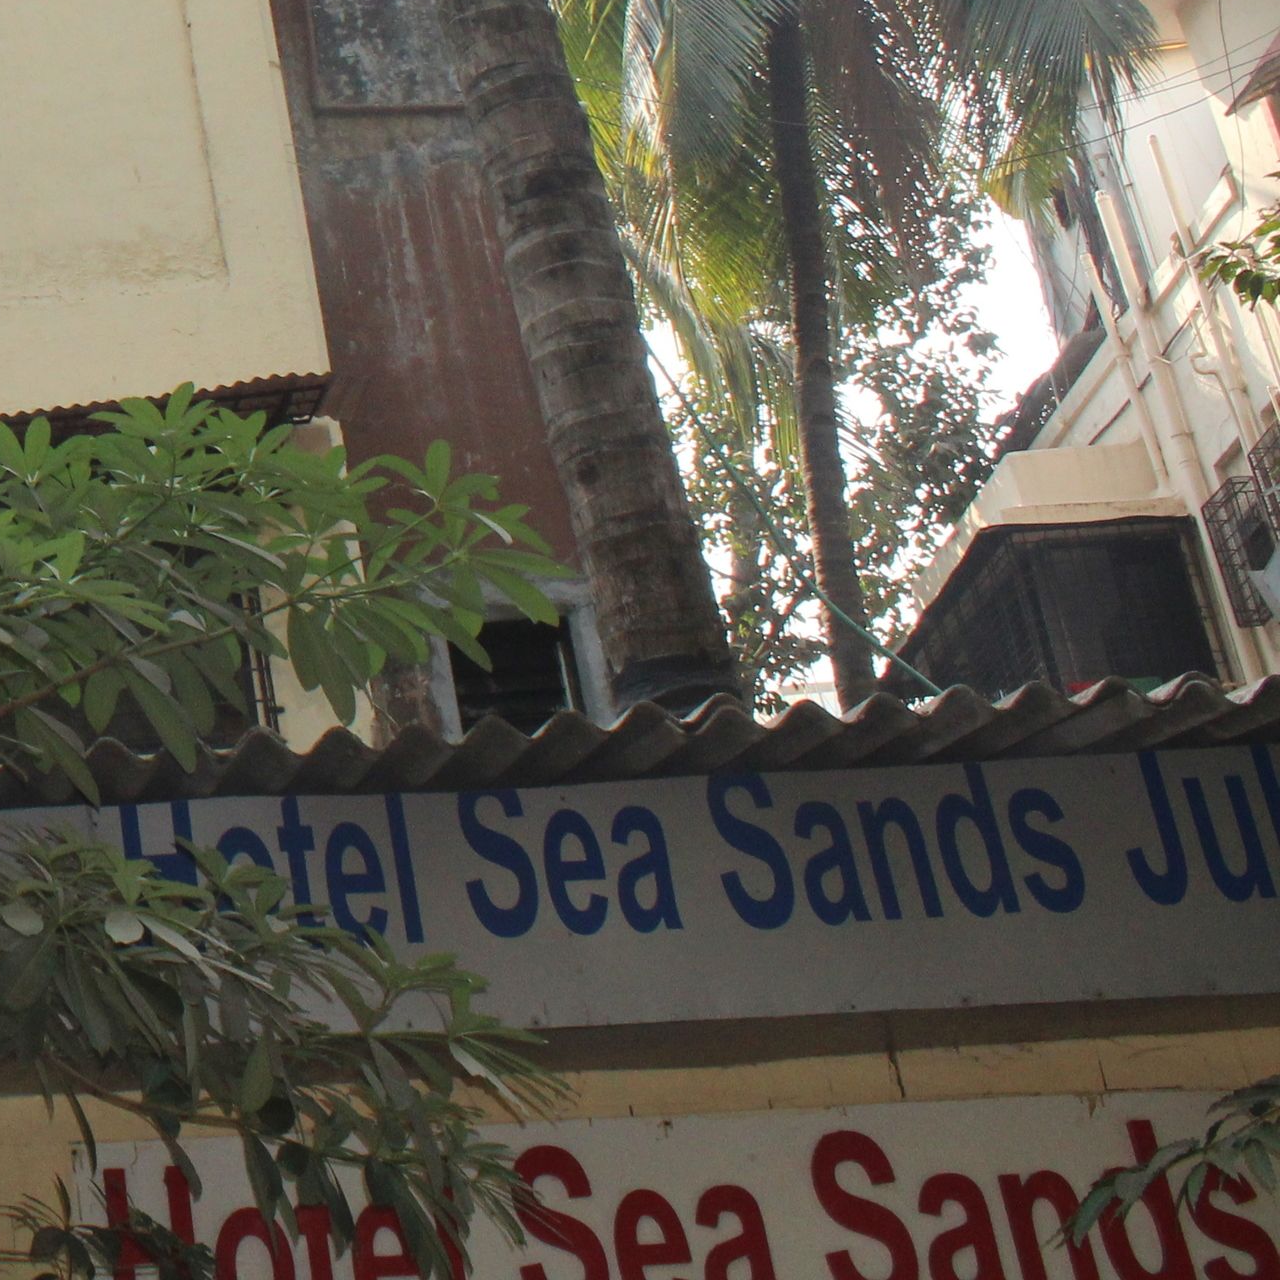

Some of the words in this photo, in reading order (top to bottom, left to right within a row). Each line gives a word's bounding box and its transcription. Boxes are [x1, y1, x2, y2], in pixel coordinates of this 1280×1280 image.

[119, 792, 424, 948] Hotel
[458, 787, 684, 938] Sea
[707, 762, 1085, 930] Sands
[1126, 744, 1280, 905] Ju
[512, 1145, 776, 1280] Sea
[811, 1120, 1280, 1280] Sands
